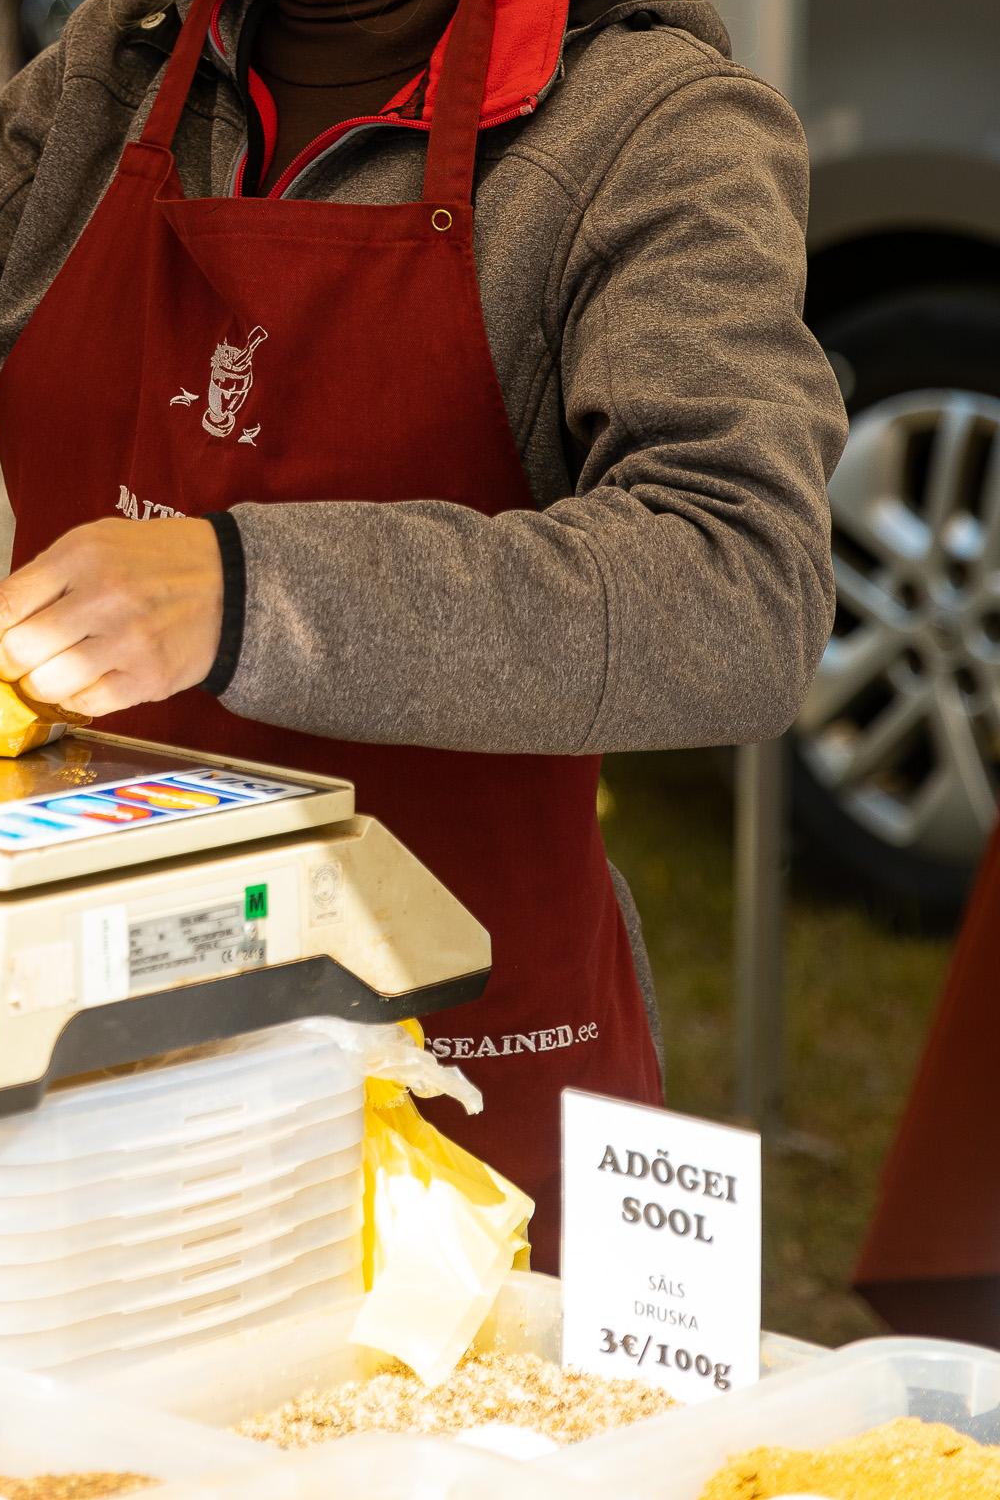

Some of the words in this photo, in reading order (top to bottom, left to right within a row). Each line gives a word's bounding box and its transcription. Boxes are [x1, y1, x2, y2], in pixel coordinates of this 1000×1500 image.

[249, 891, 264, 913] M
[424, 1021, 600, 1060] SEAINED.ee
[597, 1144, 739, 1204] ADÕGEI
[621, 1196, 714, 1244] SOOL
[648, 1274, 686, 1299] SĀLS
[633, 1300, 700, 1332] DRUSKA
[599, 1327, 732, 1392] 3€/100g
